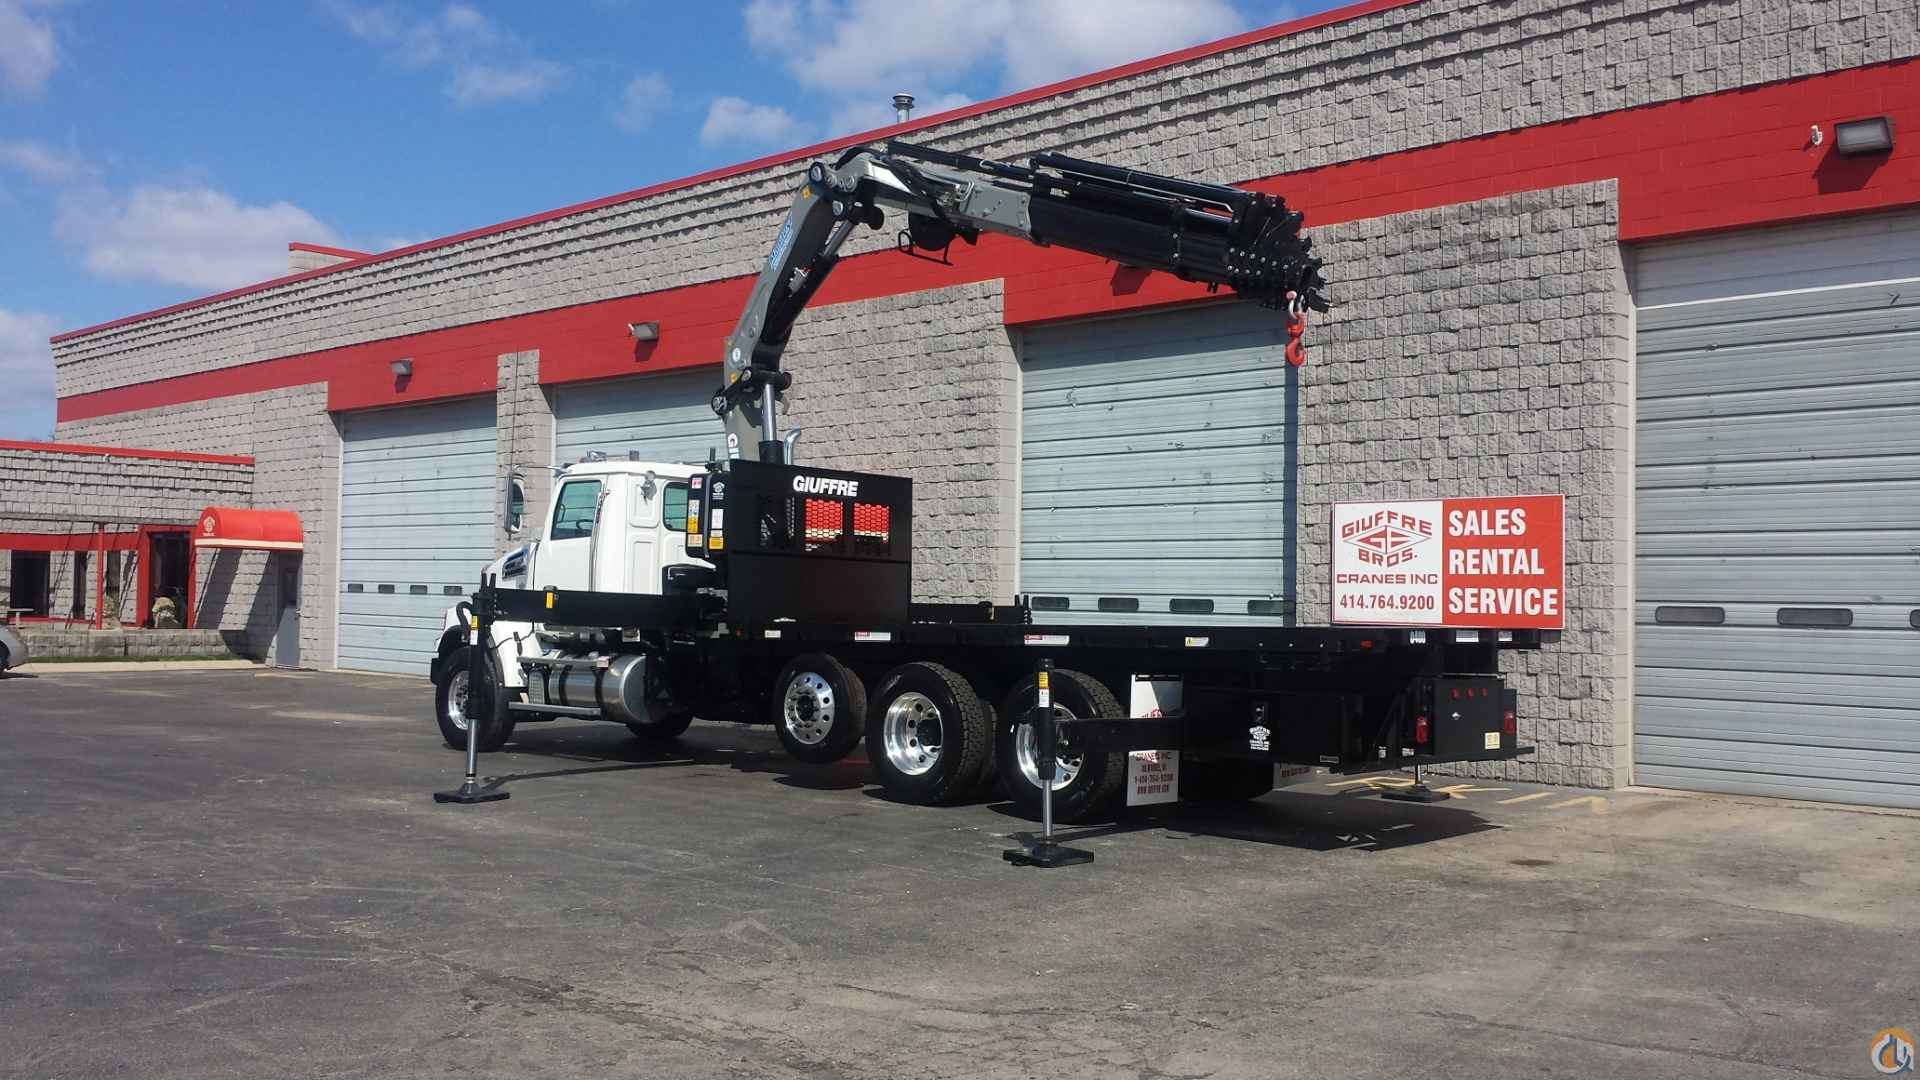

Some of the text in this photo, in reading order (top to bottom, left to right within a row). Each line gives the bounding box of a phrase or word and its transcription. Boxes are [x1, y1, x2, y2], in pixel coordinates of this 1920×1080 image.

[793, 475, 859, 497] GIUFFRE
[1342, 510, 1432, 539] GIUFFRE
[1448, 509, 1526, 537] SALES
[1358, 548, 1418, 568] BROS.
[1449, 548, 1544, 575] RENTAL
[1336, 573, 1438, 585] CRANES INC
[1340, 592, 1435, 610] 414.764.9200
[1448, 587, 1558, 616] SERVICE
